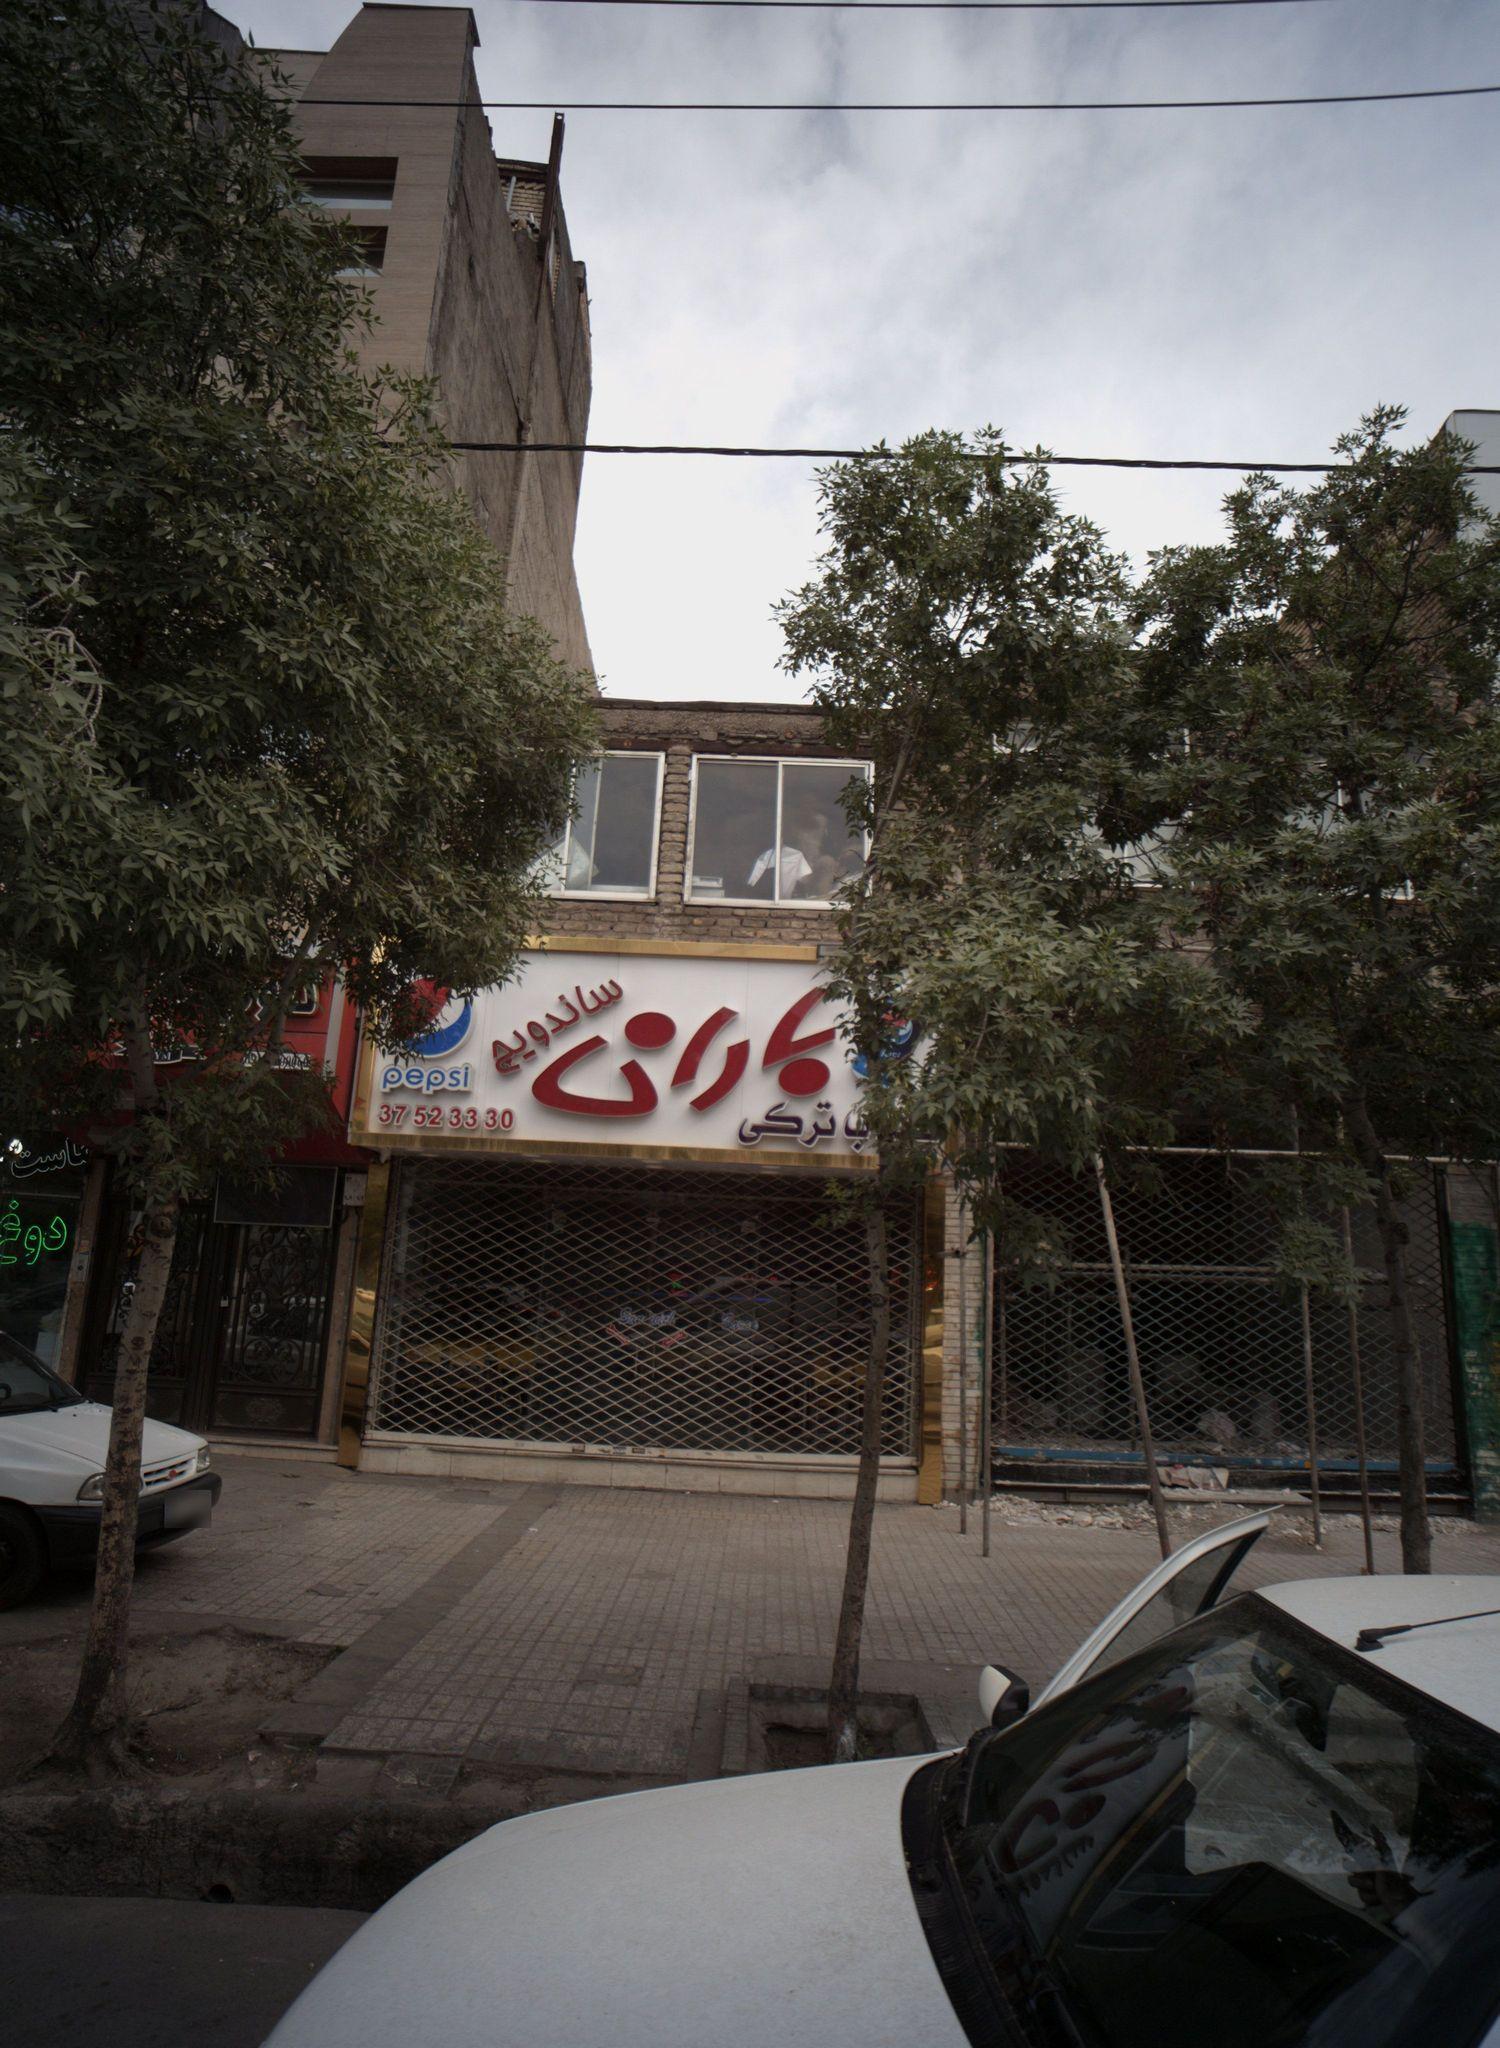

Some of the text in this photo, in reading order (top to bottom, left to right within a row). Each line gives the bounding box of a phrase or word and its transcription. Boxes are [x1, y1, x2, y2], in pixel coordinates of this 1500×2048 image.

[491, 978, 624, 1075] ساندویچ
[531, 986, 836, 1118] باران
[382, 1065, 470, 1092] pepsi
[738, 1100, 837, 1147] ترکی
